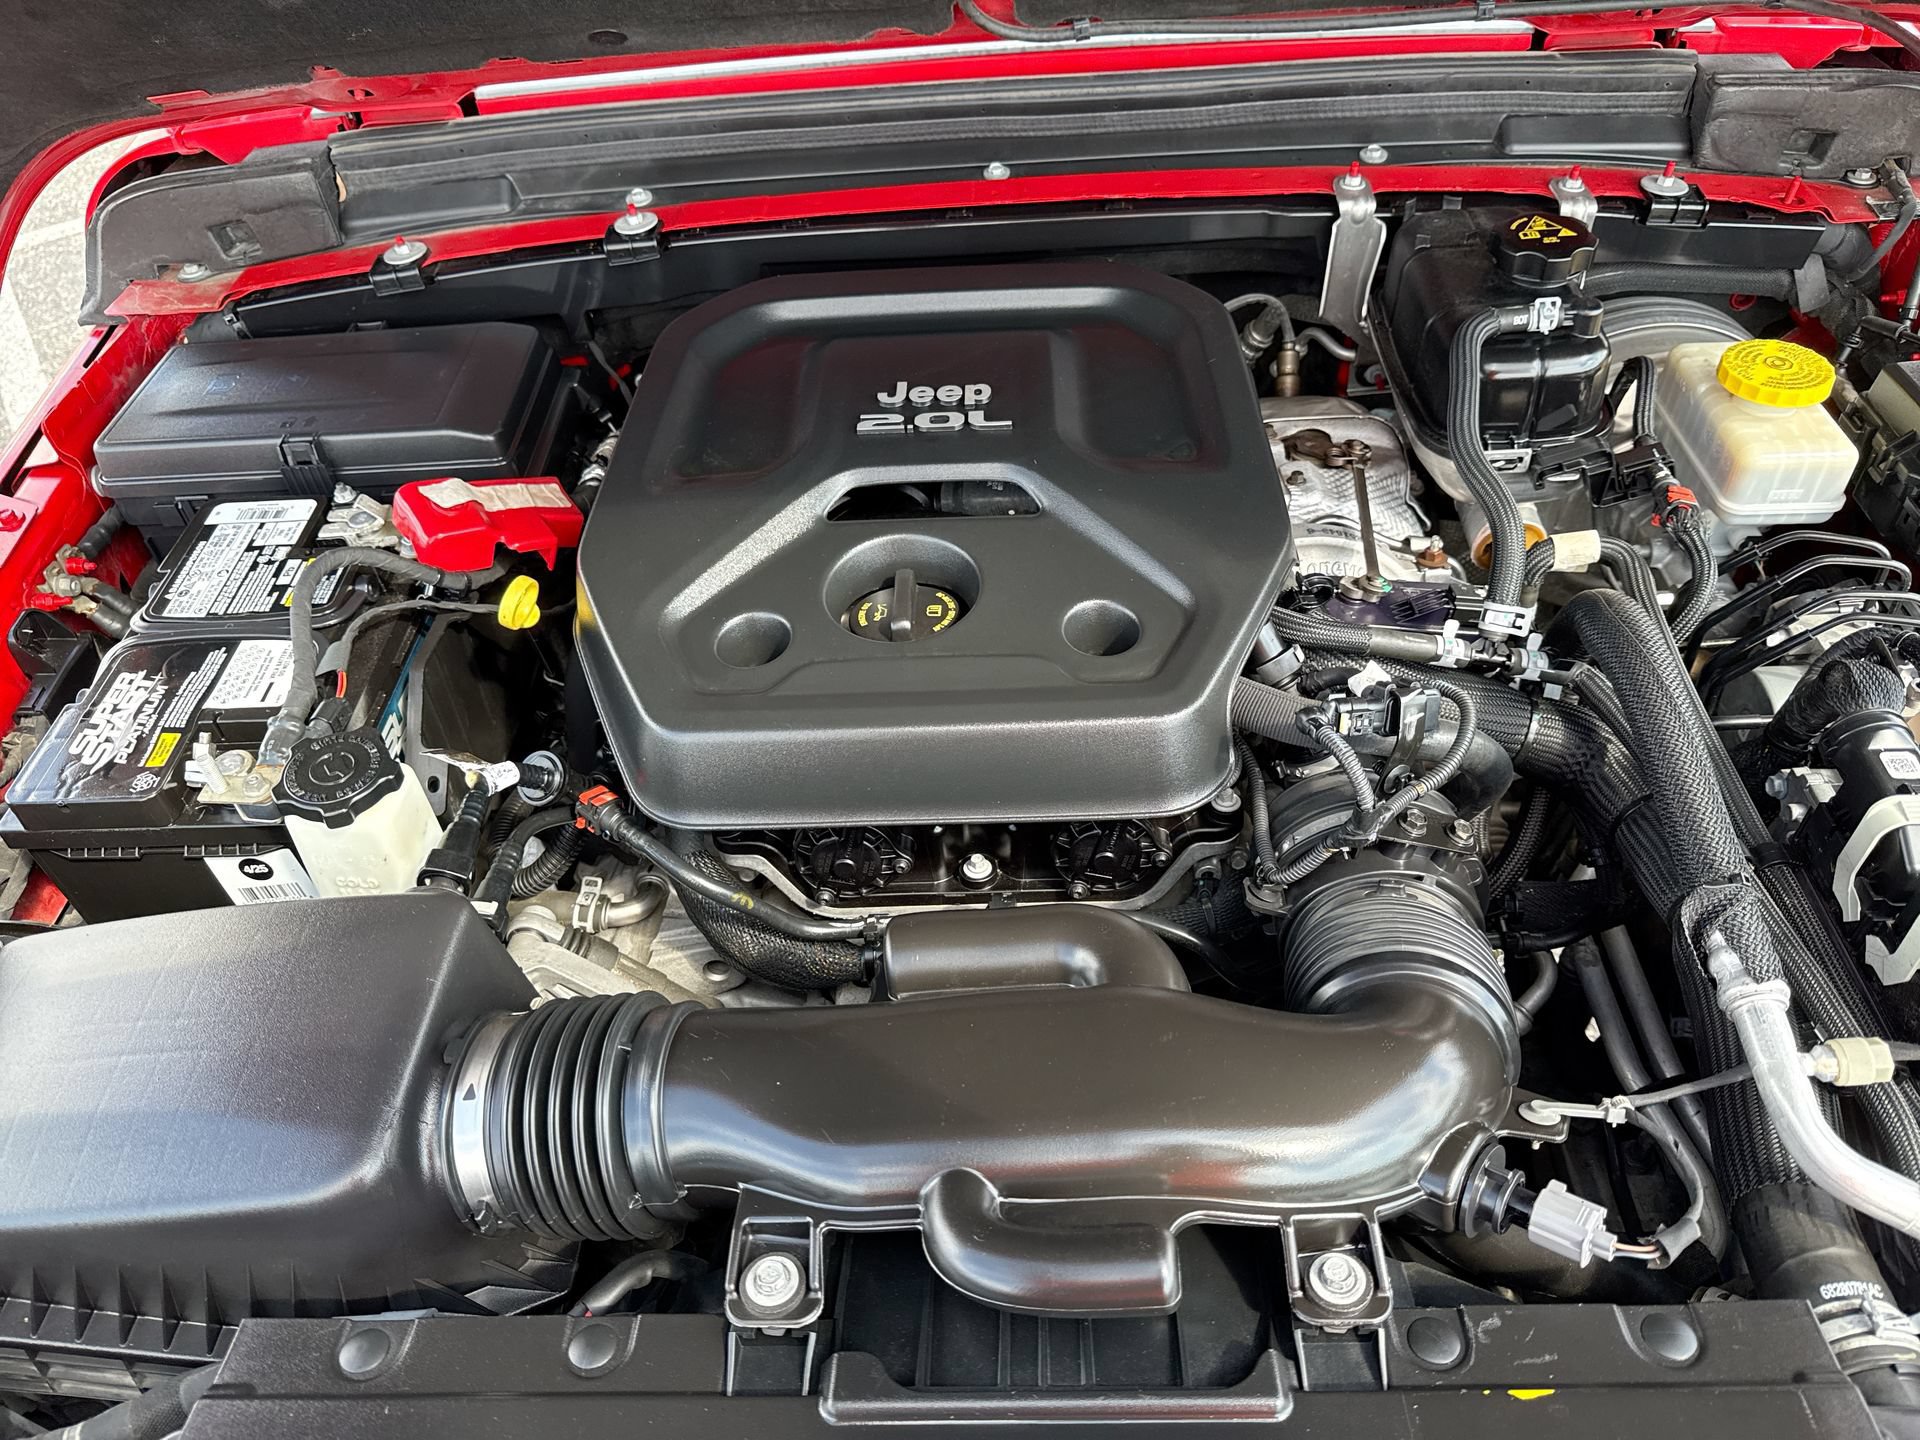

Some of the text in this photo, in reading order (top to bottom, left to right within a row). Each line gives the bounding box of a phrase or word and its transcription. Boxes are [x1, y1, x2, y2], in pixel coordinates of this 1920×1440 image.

[877, 381, 992, 409] Jeep
[856, 410, 1013, 434] 2.0L
[283, 566, 295, 577] Pb
[68, 672, 138, 754] SUPER
[80, 669, 153, 766] START
[113, 685, 168, 764] PLATINUM
[244, 864, 269, 874] 4/25
[335, 876, 380, 889] COLD
